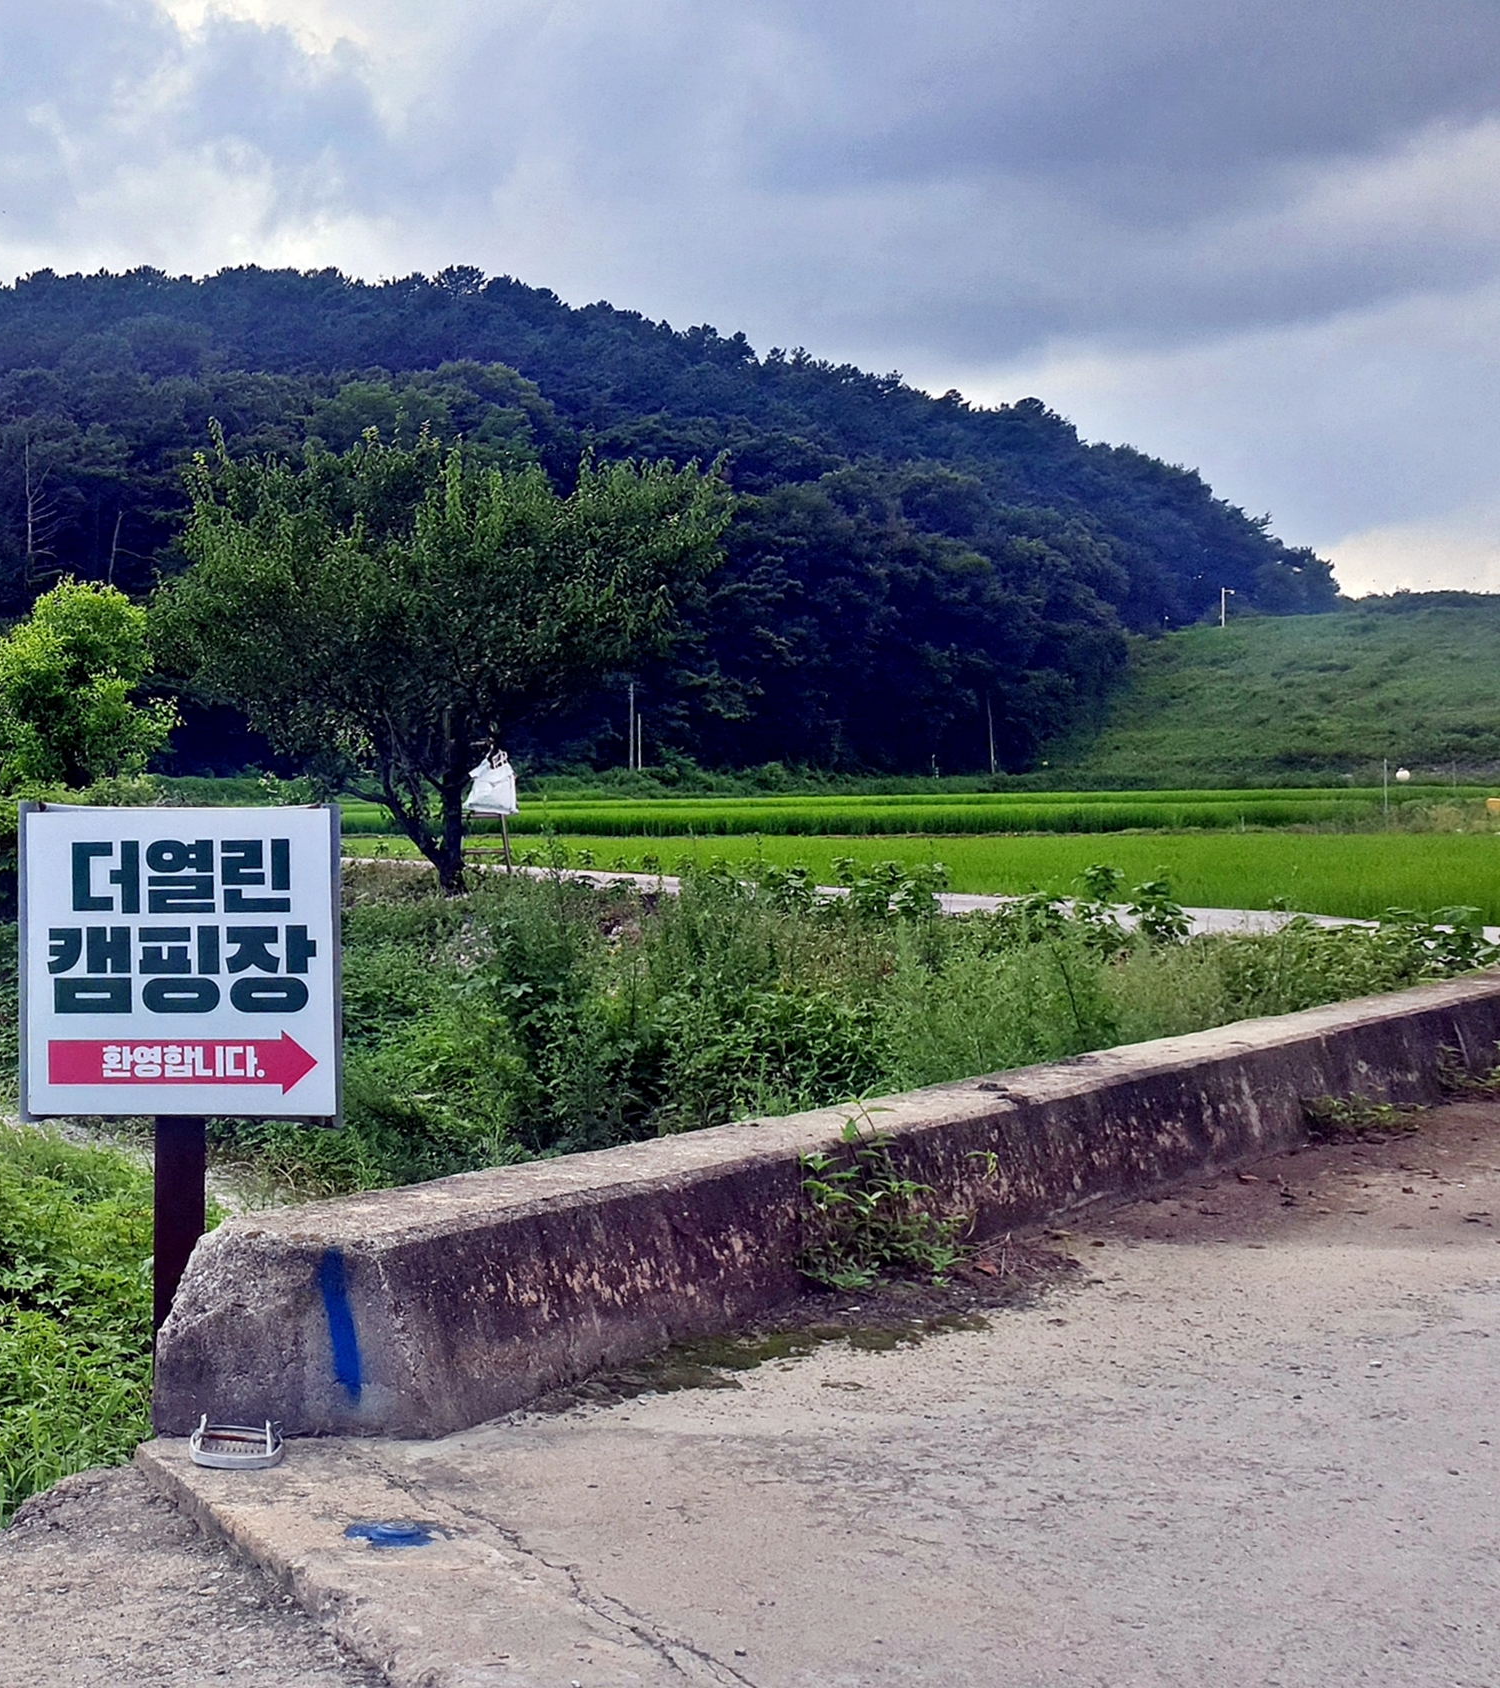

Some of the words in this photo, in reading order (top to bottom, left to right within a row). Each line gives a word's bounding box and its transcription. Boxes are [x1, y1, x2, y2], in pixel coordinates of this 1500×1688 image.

[71, 838, 291, 914] 더열린
[47, 924, 318, 1014] 캠핑장
[102, 1044, 266, 1078] 환영합니다.
